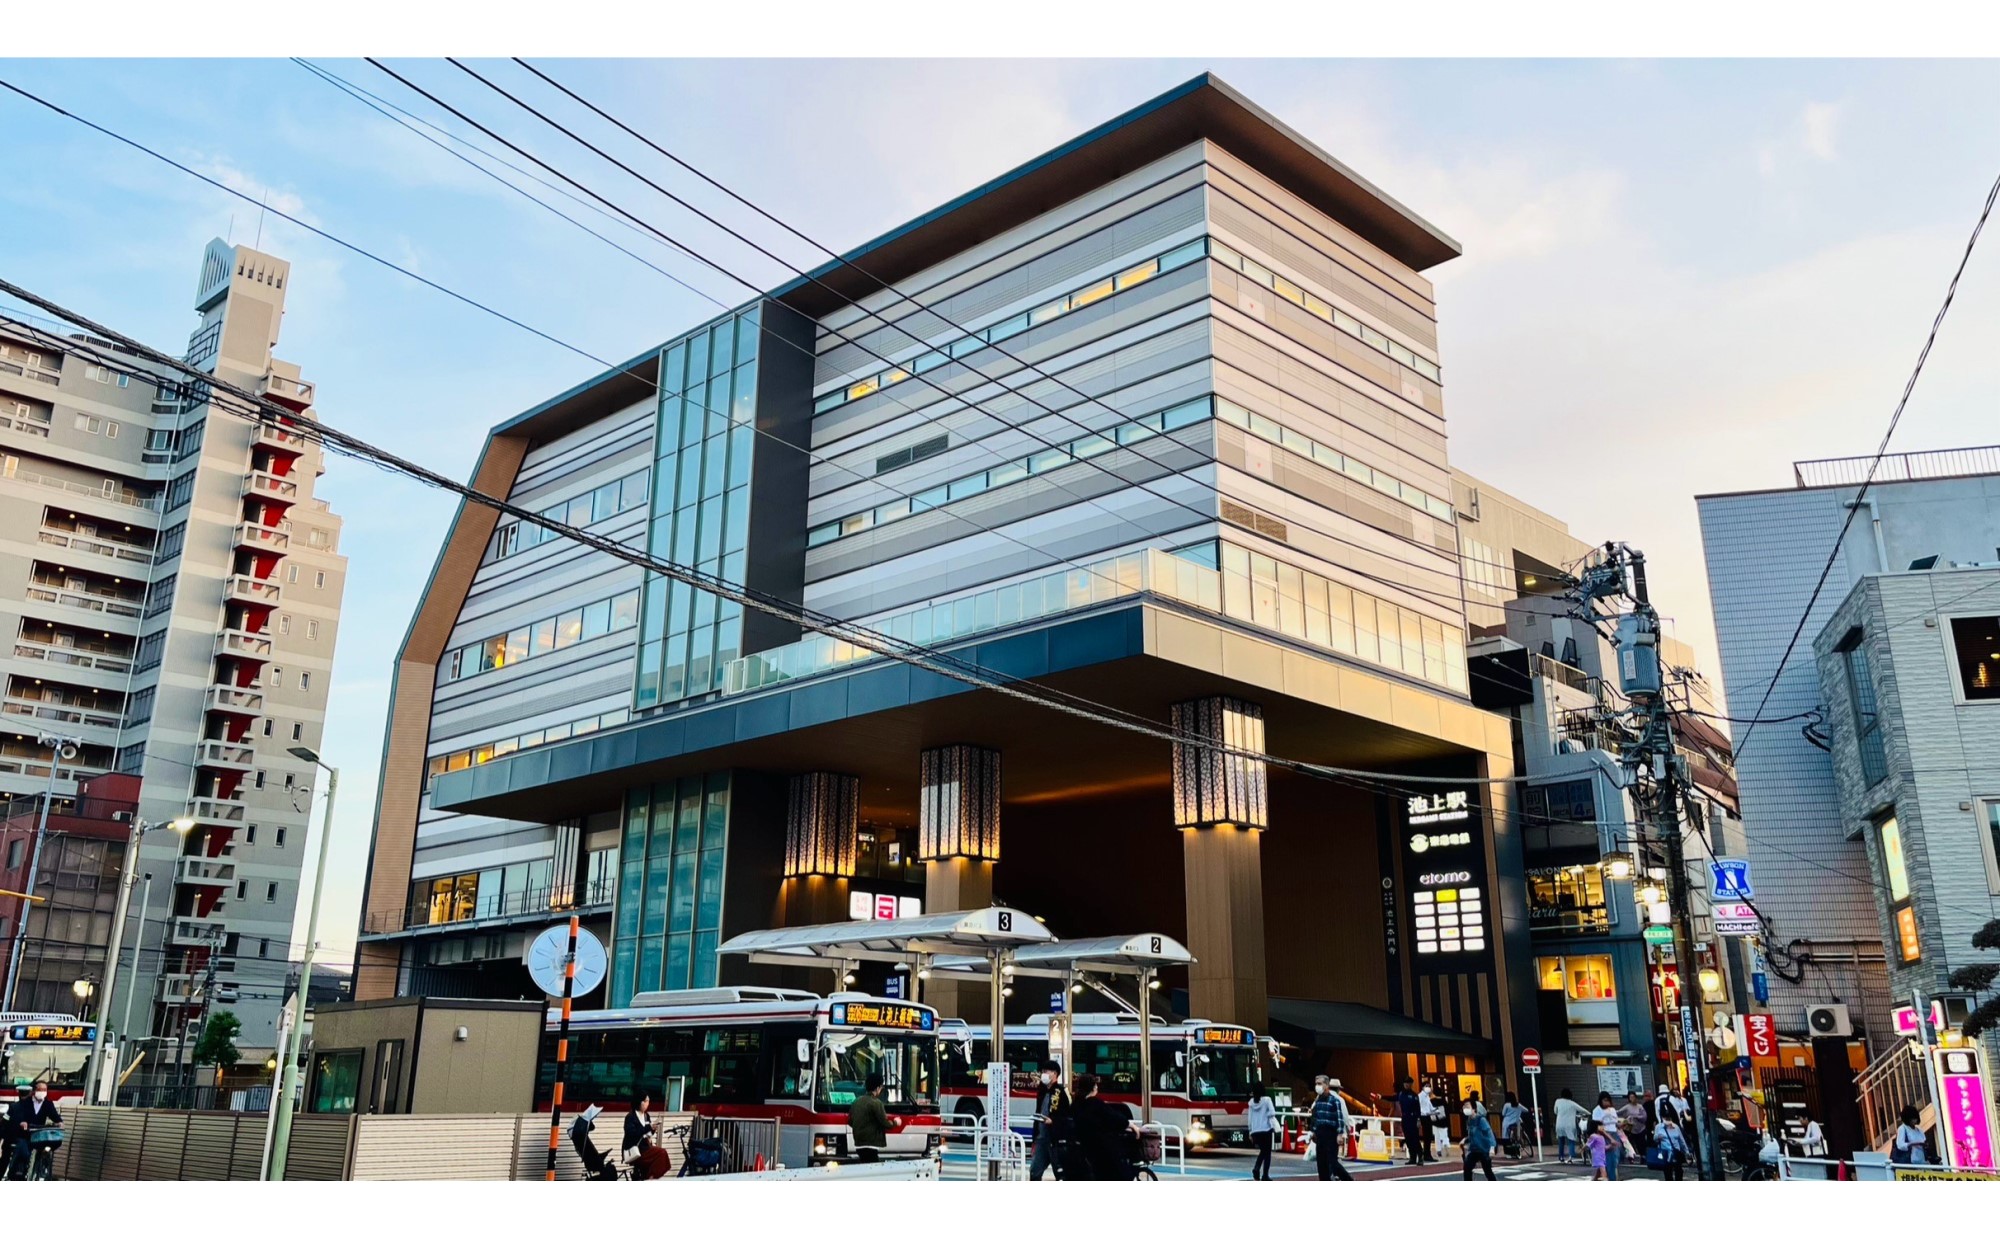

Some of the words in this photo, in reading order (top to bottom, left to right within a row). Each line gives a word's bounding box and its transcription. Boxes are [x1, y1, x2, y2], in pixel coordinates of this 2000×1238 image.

[1408, 791, 1467, 814] 池上駅
[1713, 862, 1745, 871] LAWSON
[1420, 871, 1471, 885] etomo
[1716, 888, 1748, 896] STATON
[1001, 914, 1009, 930] 3
[1153, 938, 1160, 952] 2
[1052, 1020, 1059, 1032] 2
